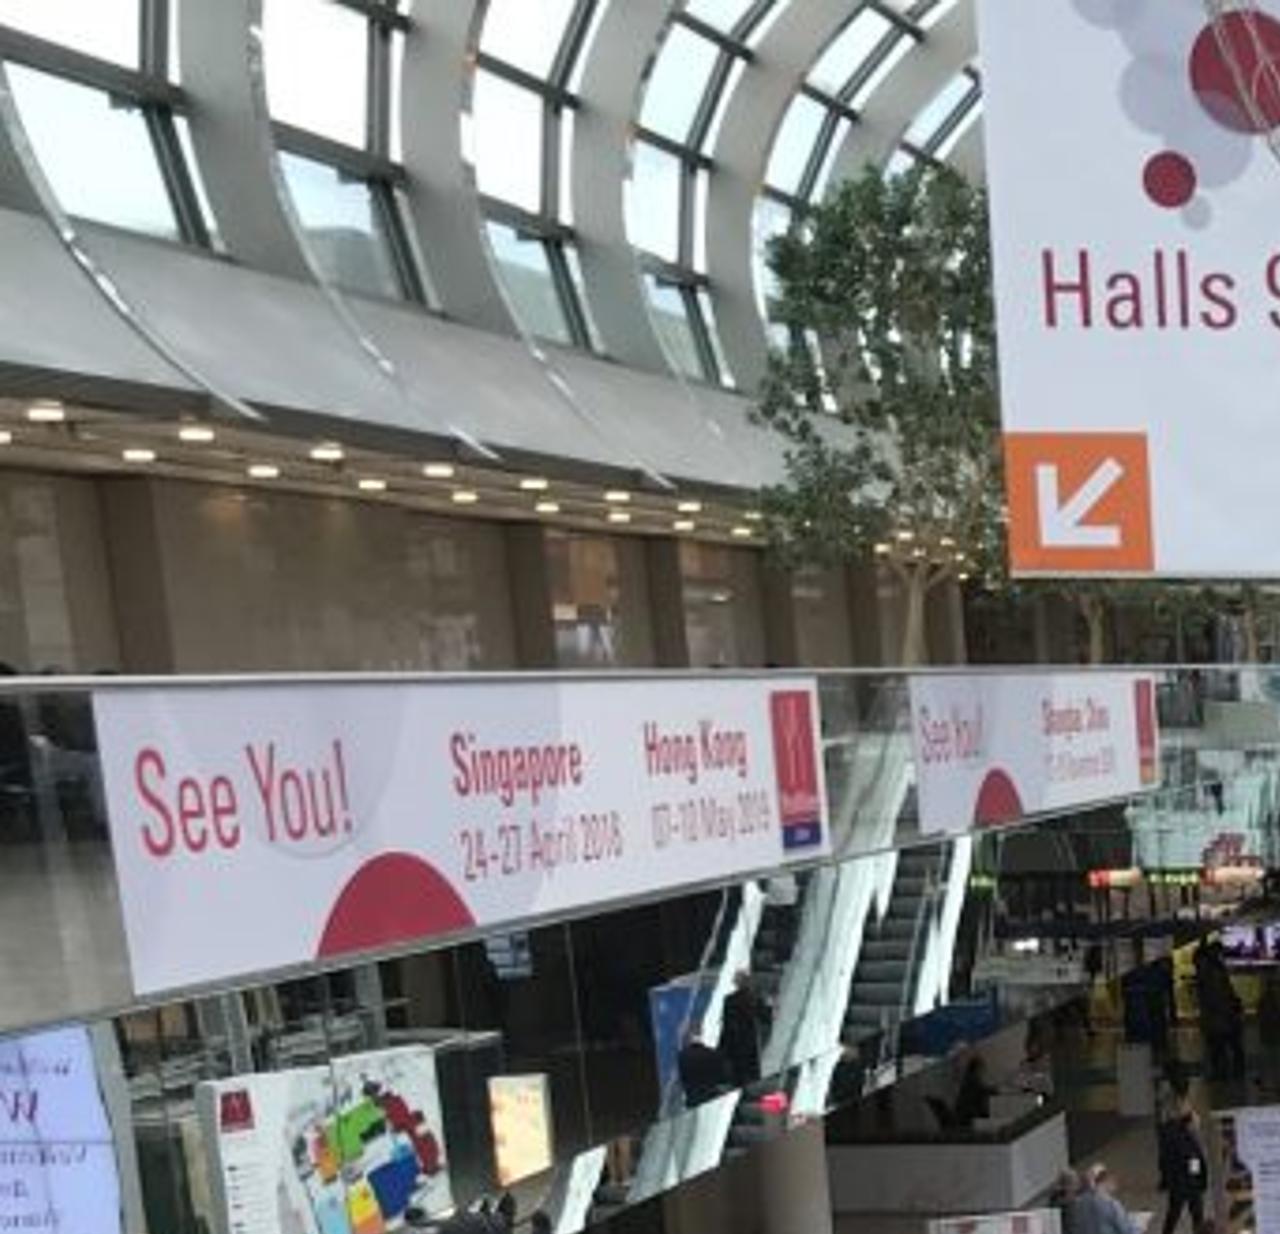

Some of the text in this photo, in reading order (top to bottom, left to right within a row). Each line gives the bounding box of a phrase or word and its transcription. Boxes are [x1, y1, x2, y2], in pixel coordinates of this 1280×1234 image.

[1042, 249, 1236, 329] Halls
[450, 732, 582, 807] Singapore
[644, 718, 747, 784] Hong Kong
[134, 738, 354, 859] See You!
[530, 815, 577, 876] April
